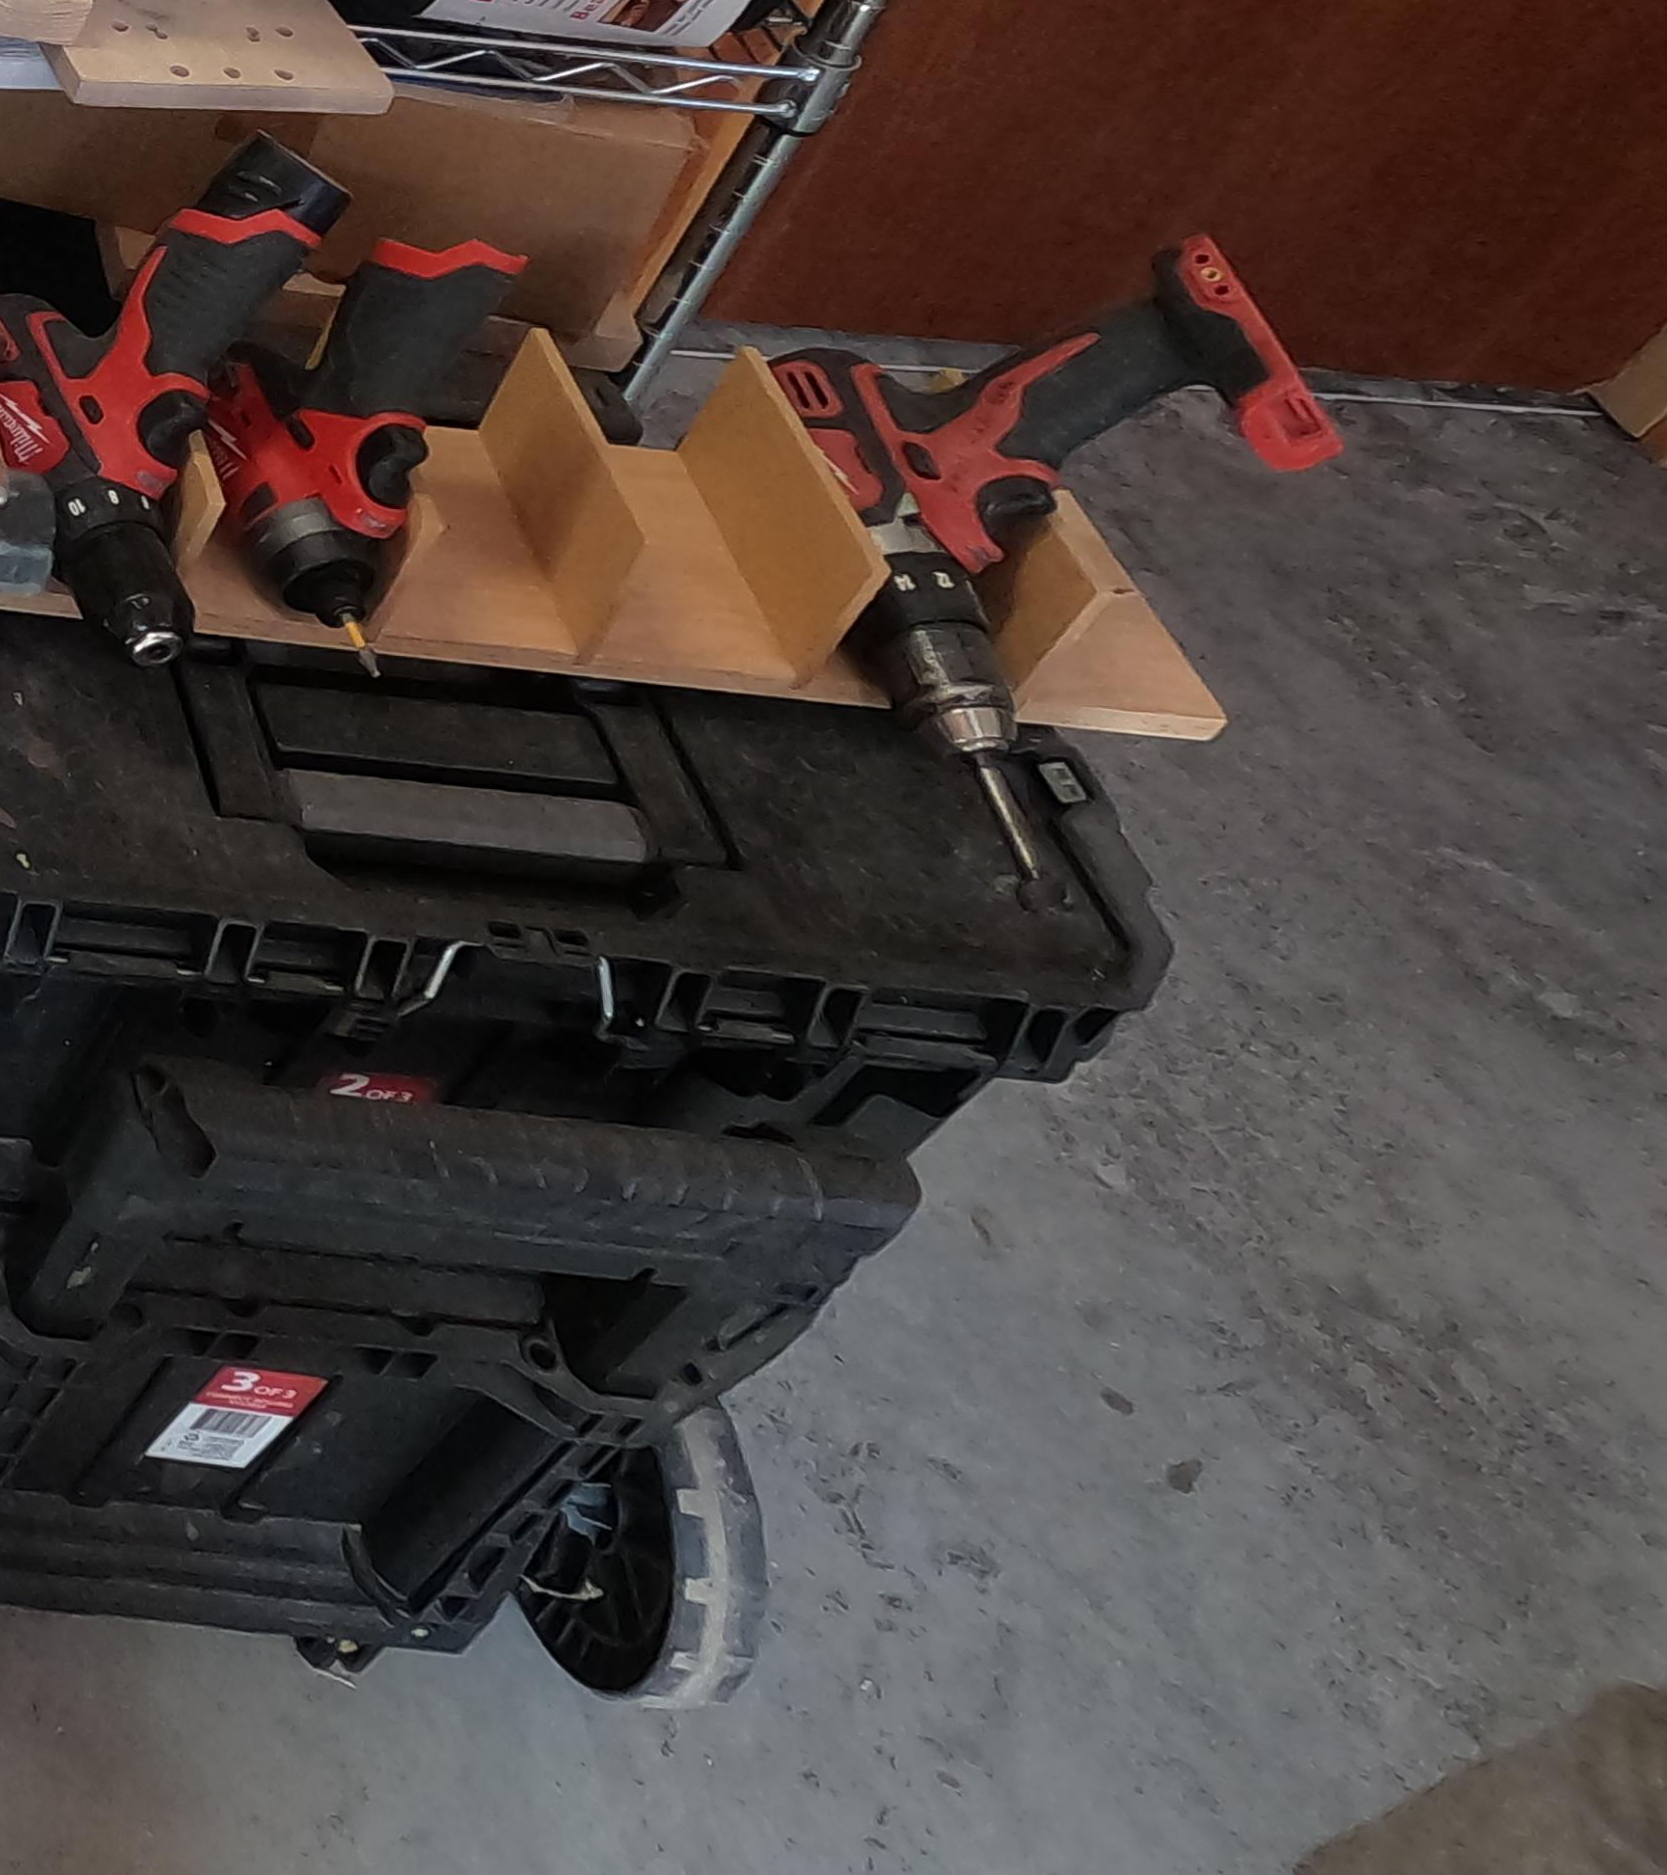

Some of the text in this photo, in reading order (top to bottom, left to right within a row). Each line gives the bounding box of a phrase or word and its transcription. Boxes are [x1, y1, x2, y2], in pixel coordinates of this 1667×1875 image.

[329, 1074, 371, 1098] 2
[366, 1087, 398, 1101] OF
[219, 1370, 261, 1393] 3
[253, 1384, 284, 1398] OF
